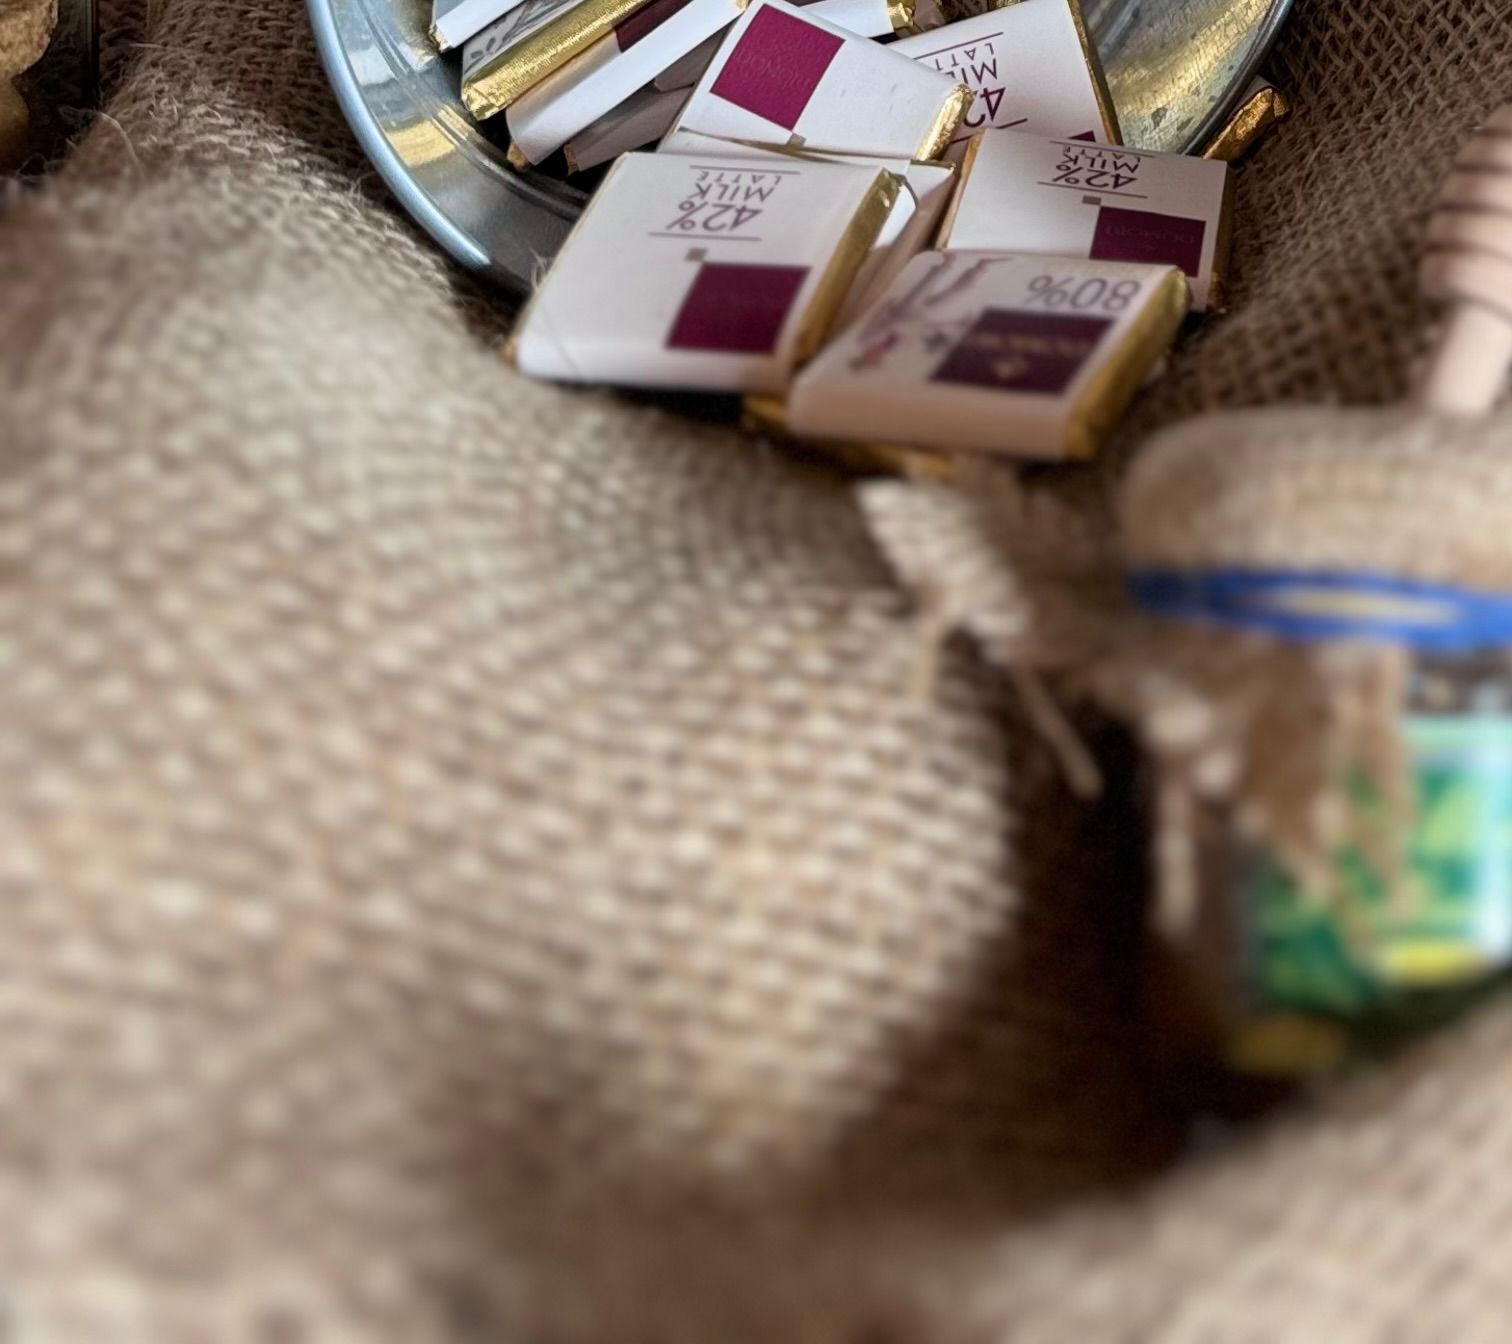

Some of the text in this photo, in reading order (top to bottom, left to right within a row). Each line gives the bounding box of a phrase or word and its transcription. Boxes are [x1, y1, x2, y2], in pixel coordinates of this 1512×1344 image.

[935, 42, 994, 72] LATT
[963, 86, 1006, 128] 42
[1052, 163, 1139, 189] 42%
[1063, 153, 1140, 173] MILK
[687, 182, 775, 202] MILK
[697, 170, 782, 186] LATTE
[666, 200, 763, 231] 42%
[1024, 274, 1142, 311] 80%
